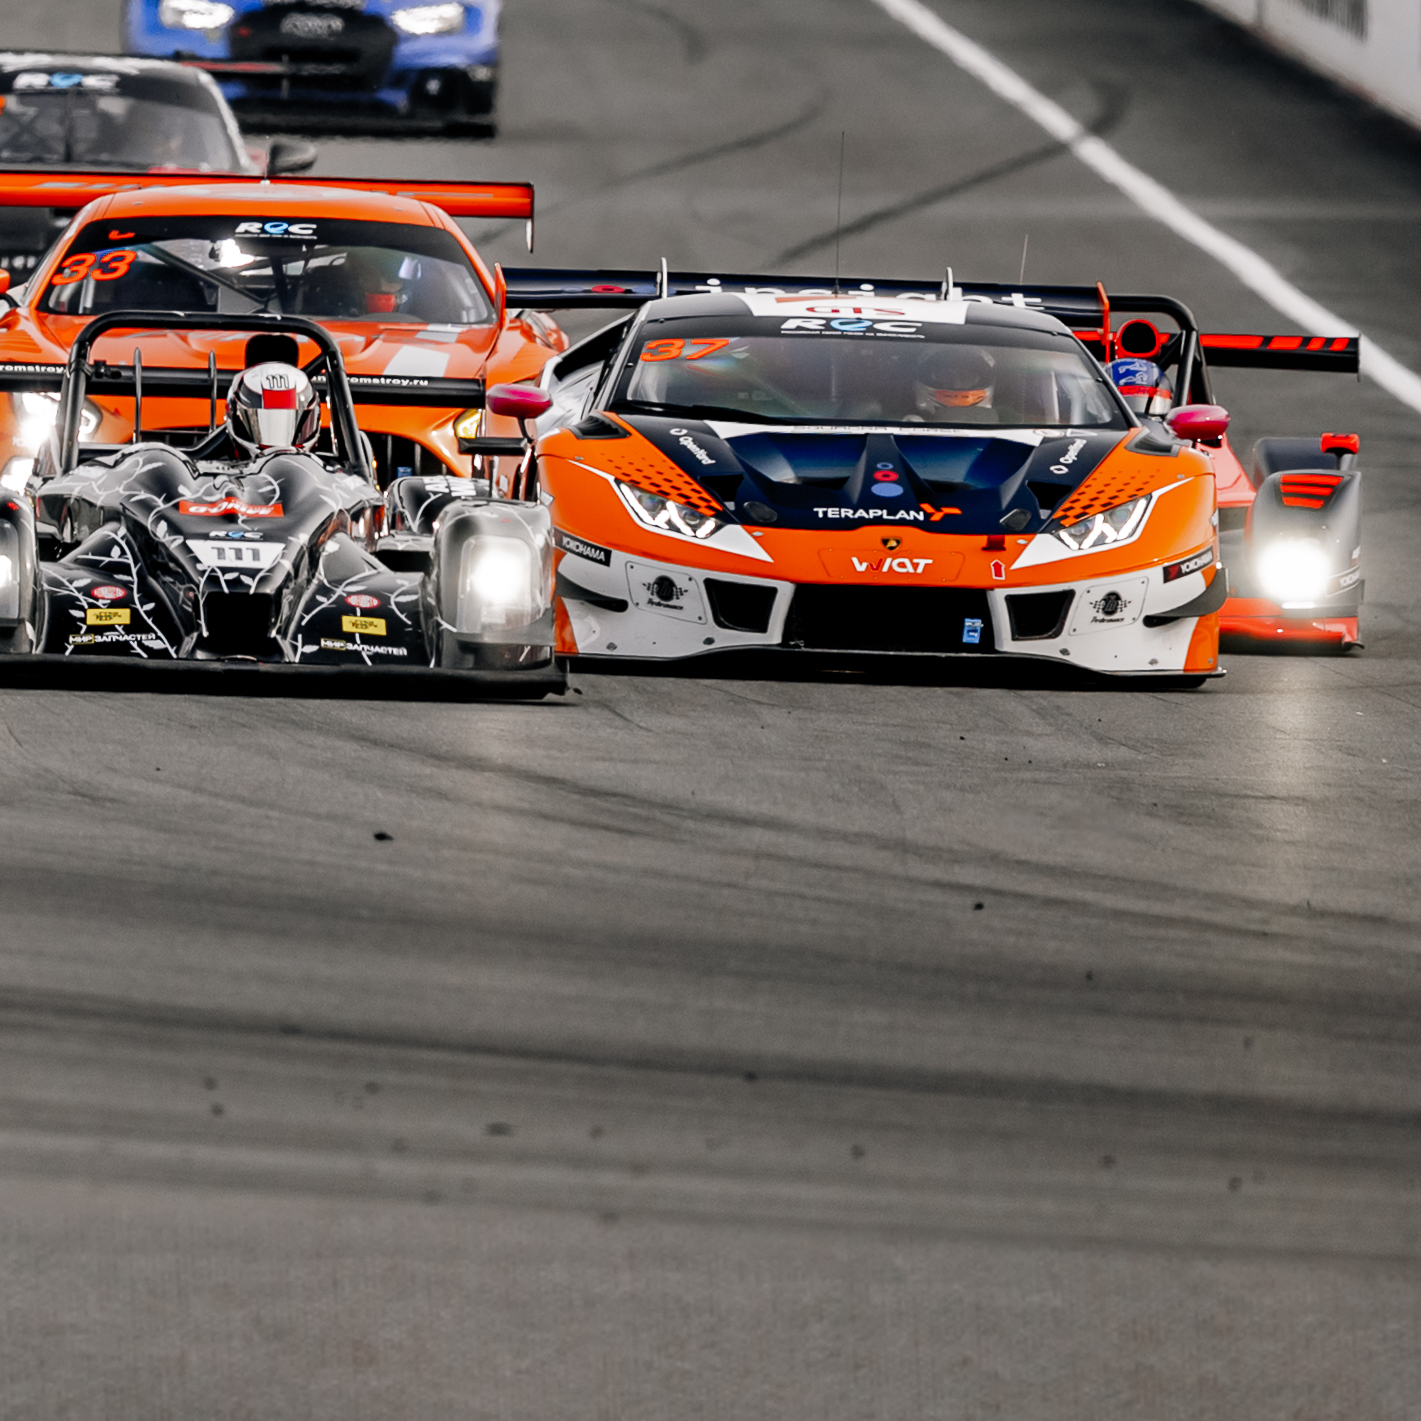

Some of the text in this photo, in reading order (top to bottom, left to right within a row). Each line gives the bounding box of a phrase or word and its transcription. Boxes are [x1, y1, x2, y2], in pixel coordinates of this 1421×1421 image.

[51, 250, 137, 286] 33
[640, 339, 730, 362] 37
[813, 507, 925, 521] TERAPLAN
[211, 546, 261, 562] 111
[562, 536, 606, 562] YOKOHAMA
[69, 632, 156, 644] МИР ЗАПЧАСТЕЙ
